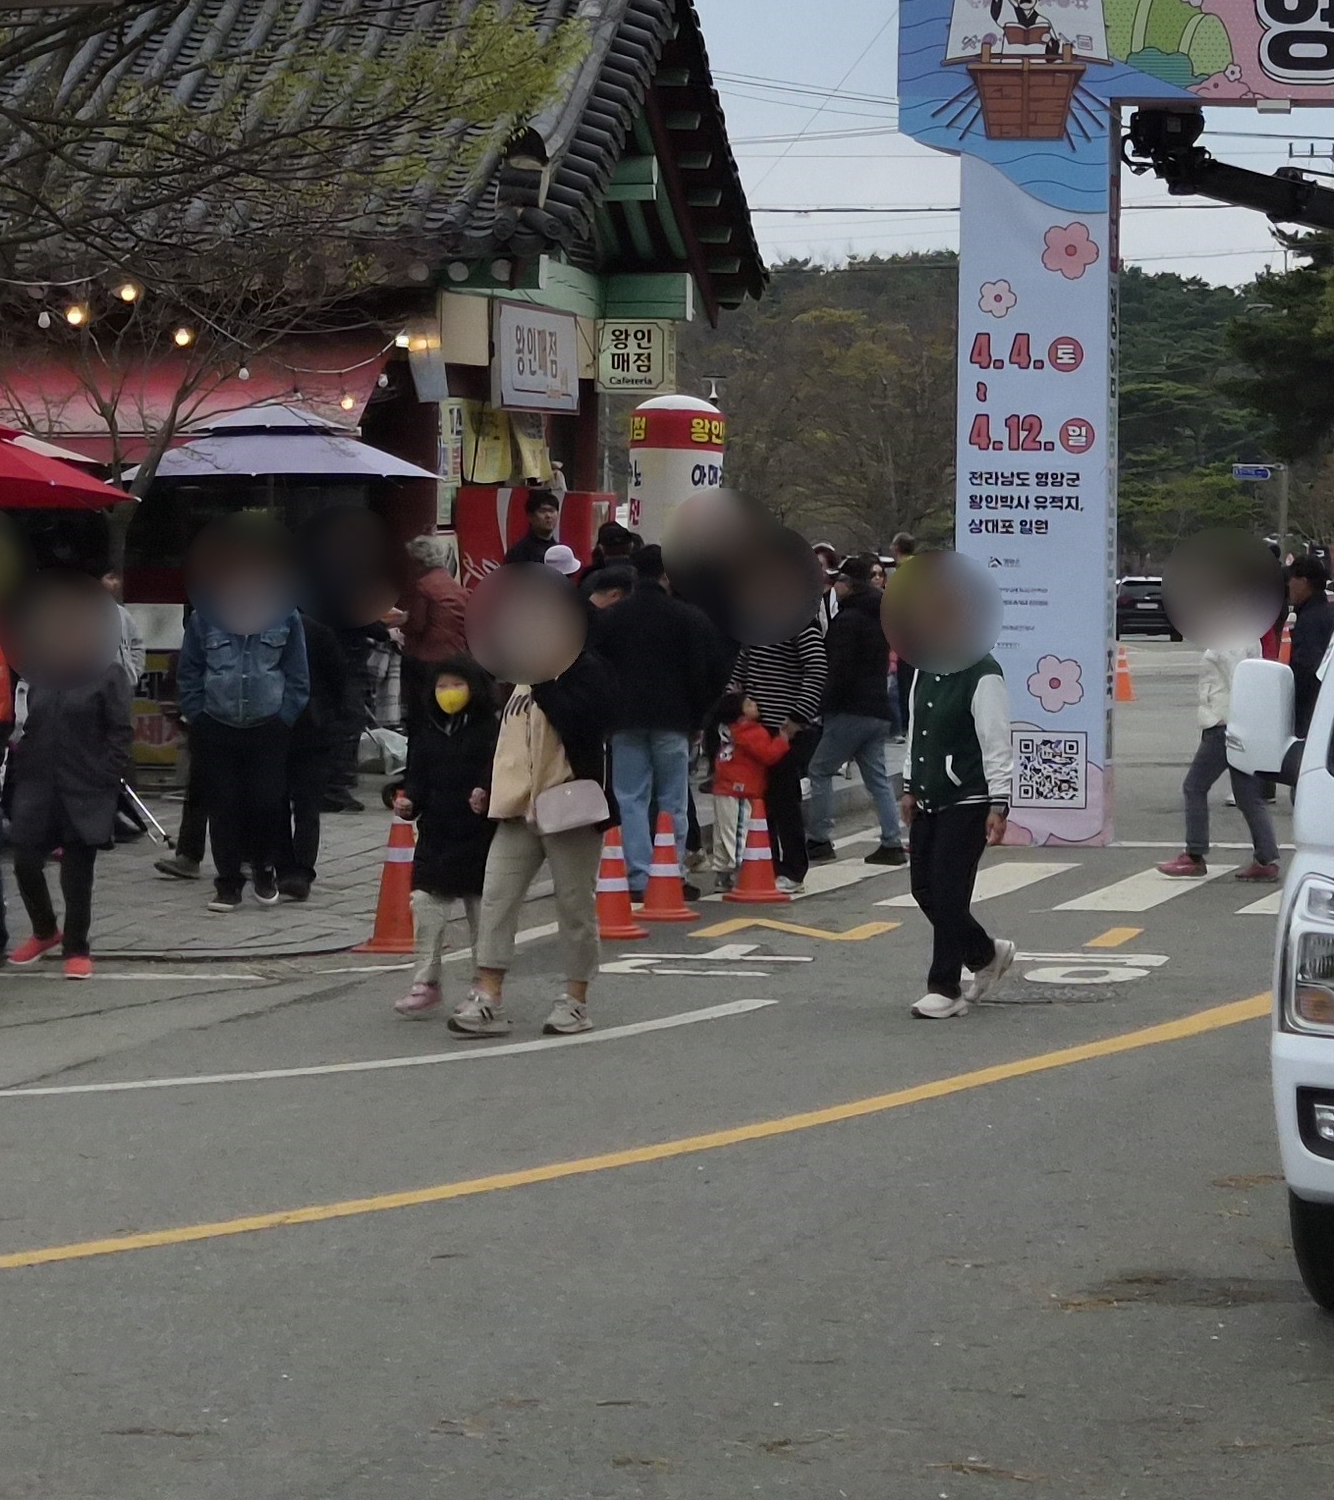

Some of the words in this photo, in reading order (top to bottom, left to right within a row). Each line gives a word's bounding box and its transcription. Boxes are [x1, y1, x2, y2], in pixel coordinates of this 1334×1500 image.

[611, 328, 652, 350] 왕인
[610, 352, 652, 373] 매점
[609, 376, 652, 385] Cafeteria
[968, 414, 1054, 452] 4.12.
[968, 470, 1030, 488] 전라남도
[1035, 469, 1081, 487] 영암군
[968, 493, 1030, 512] 왕인박사
[1034, 493, 1084, 513] 유적지,
[968, 517, 1015, 535] 상대포
[1019, 517, 1049, 535] 일원
